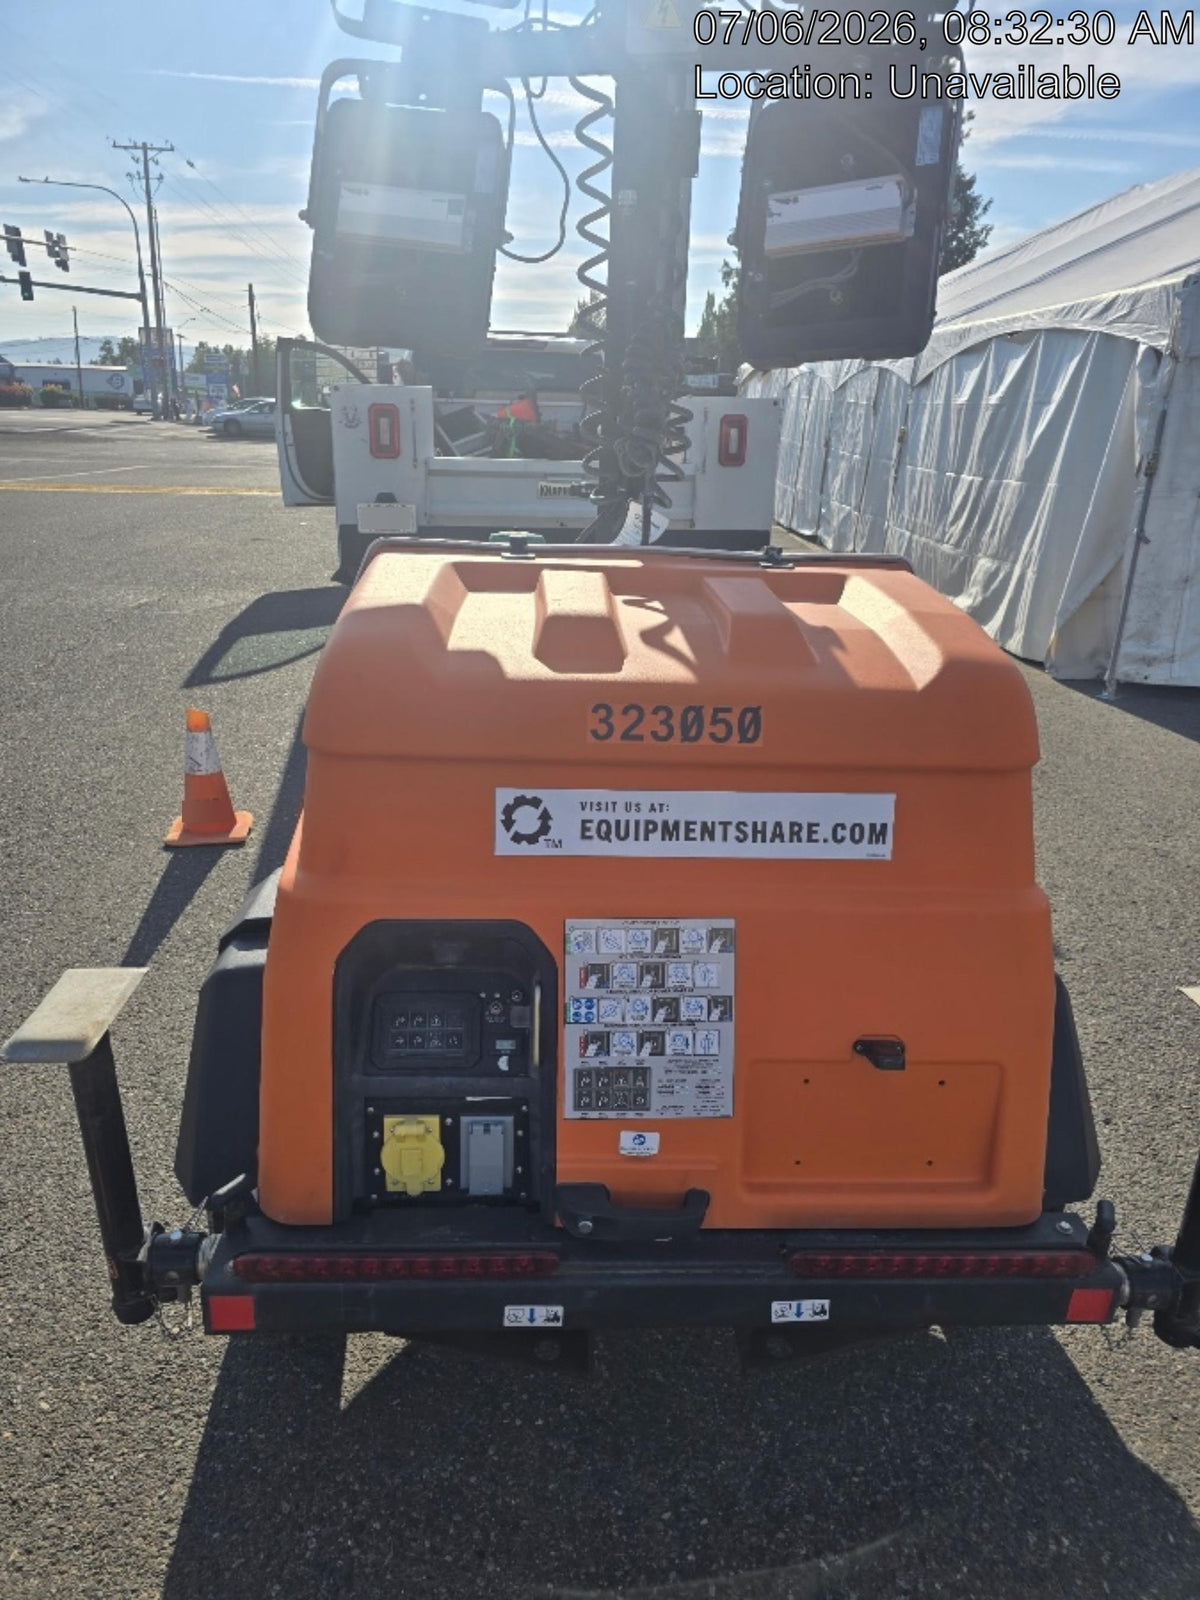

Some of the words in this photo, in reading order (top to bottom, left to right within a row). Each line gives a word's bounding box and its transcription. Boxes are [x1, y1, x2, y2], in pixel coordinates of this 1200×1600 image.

[590, 703, 762, 744] 323050
[579, 801, 618, 813] VISIT
[624, 802, 642, 813] US
[648, 802, 670, 814] AT:
[580, 819, 888, 845] EQUIPMENTSHARE.COM
